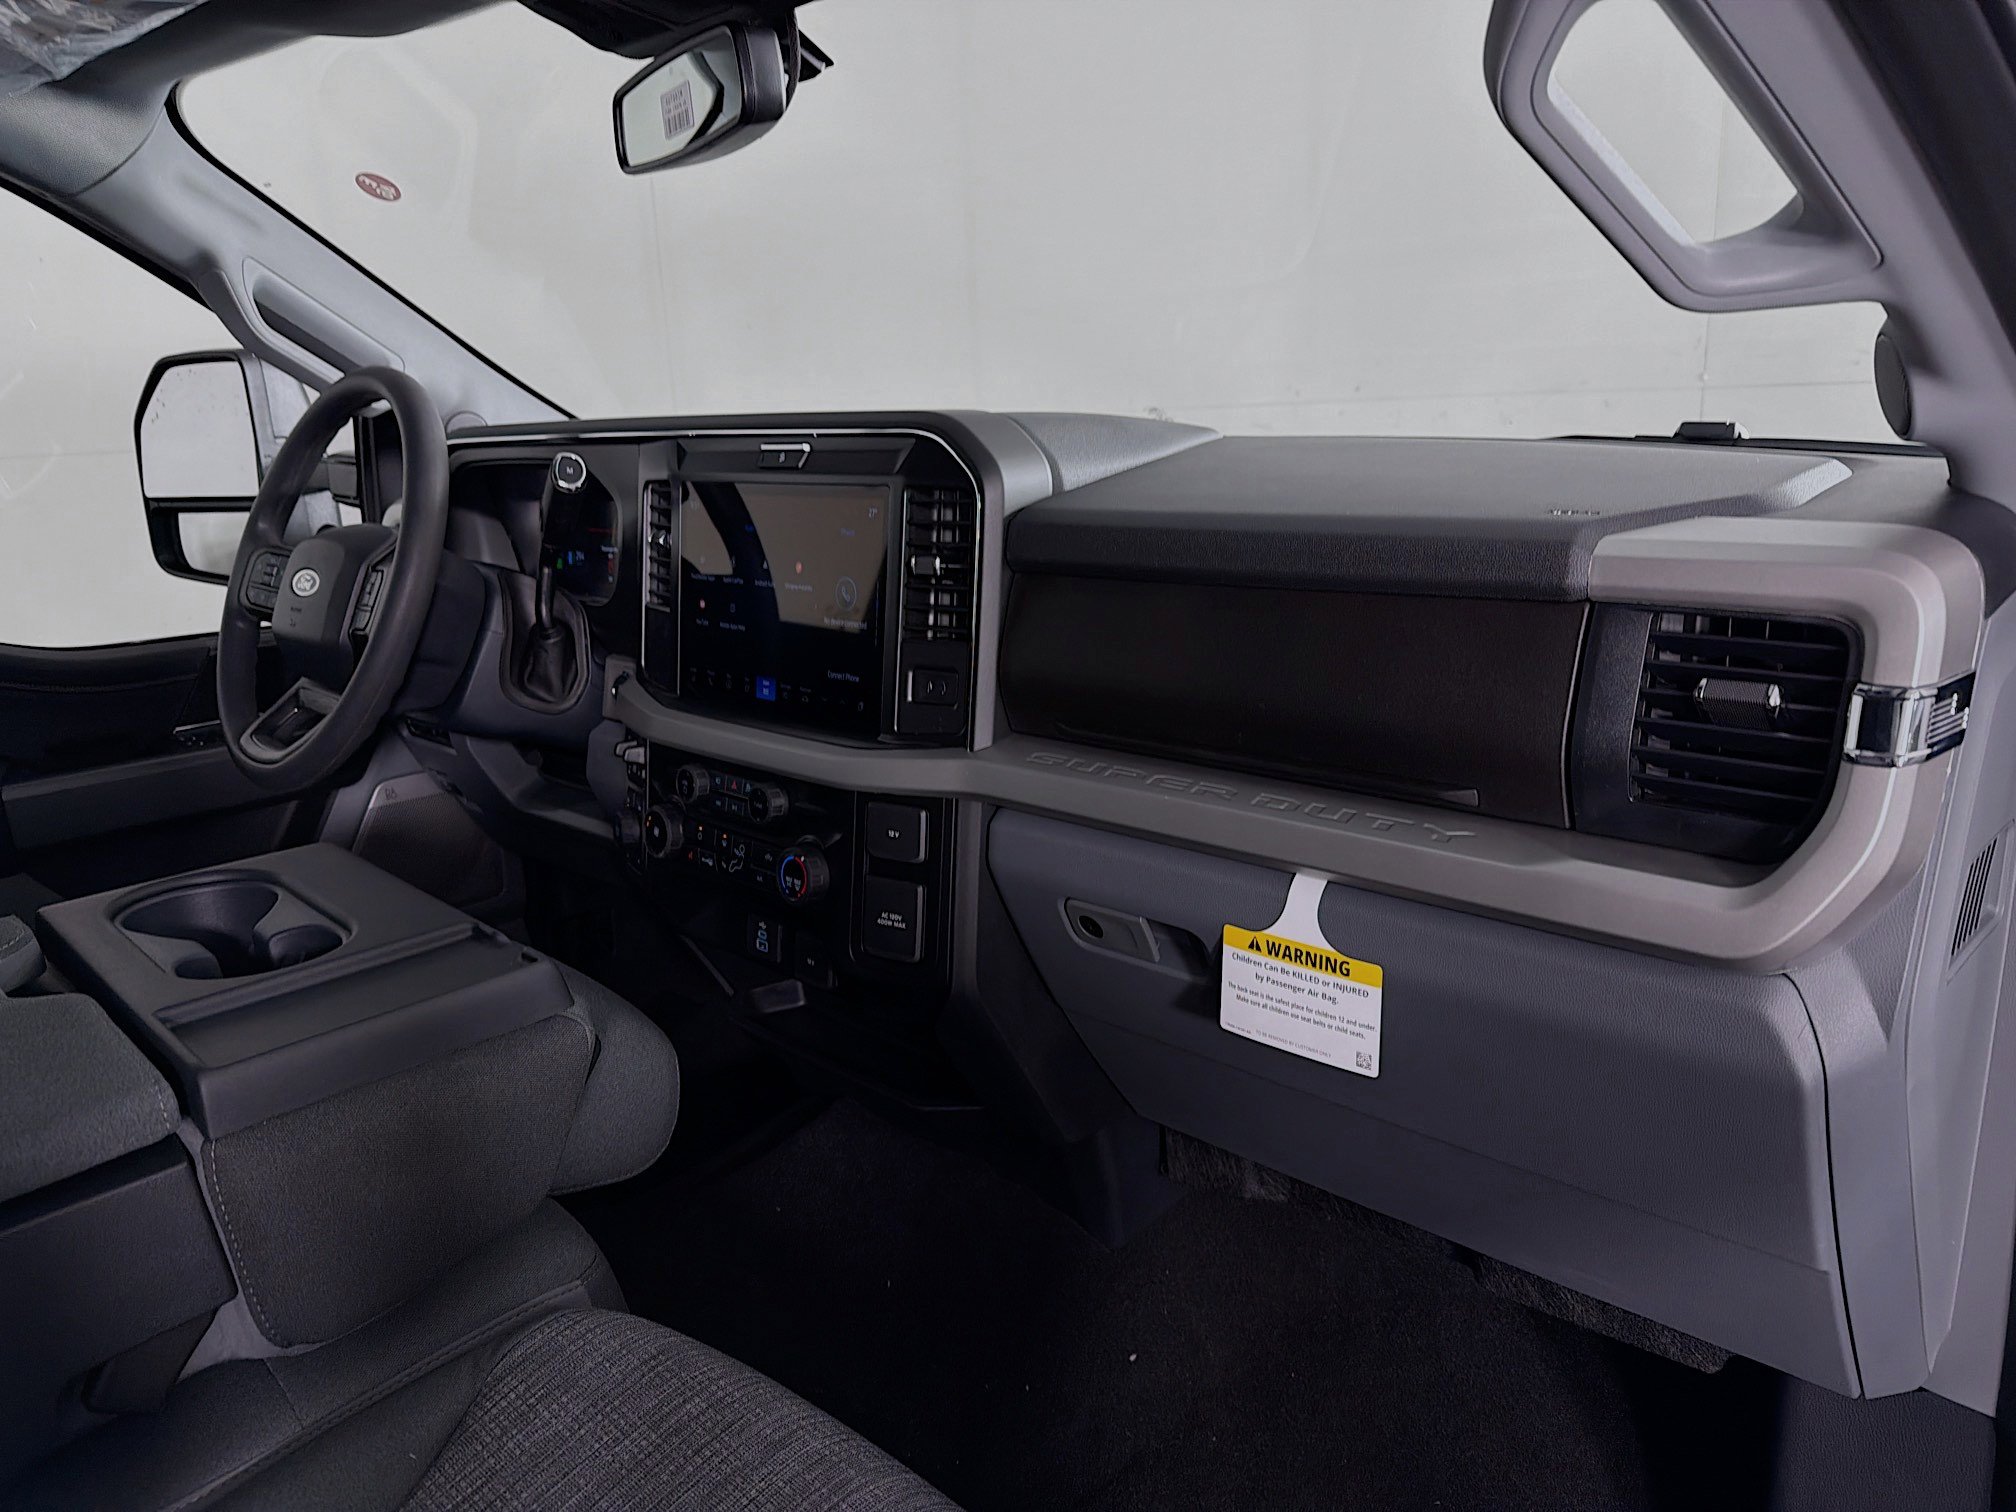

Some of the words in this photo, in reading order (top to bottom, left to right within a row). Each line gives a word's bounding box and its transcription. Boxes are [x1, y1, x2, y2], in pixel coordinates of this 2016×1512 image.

[566, 466, 575, 475] M
[1027, 752, 1238, 800] SUPER
[1250, 793, 1476, 843] DUTY
[887, 828, 900, 839] 12V
[893, 920, 907, 930] MAX
[1231, 952, 1263, 968] Children
[1263, 962, 1279, 973] Can
[1280, 967, 1291, 976] Be
[1292, 970, 1320, 985] KILLED
[1321, 980, 1331, 988] or
[1332, 982, 1370, 998] INJURED
[1266, 939, 1351, 977] WARNING
[1228, 981, 1237, 990] The
[1237, 985, 1248, 993] back
[1265, 994, 1274, 1002] the
[1275, 998, 1290, 1007] safest
[1291, 1002, 1305, 1011] place
[1305, 1005, 1314, 1014] for
[1314, 1009, 1337, 1021] children
[1338, 1015, 1345, 1023] 12
[1346, 1018, 1357, 1027] and
[1255, 972, 1265, 983] by
[1265, 976, 1306, 994] Passenger
[1307, 988, 1319, 998] Air
[1236, 993, 1249, 1003] Make
[1268, 1005, 1290, 1016] children
[1290, 1012, 1300, 1020] use
[1300, 1015, 1312, 1024] seat
[1312, 1017, 1326, 1028] belts
[1334, 1025, 1348, 1034] child
